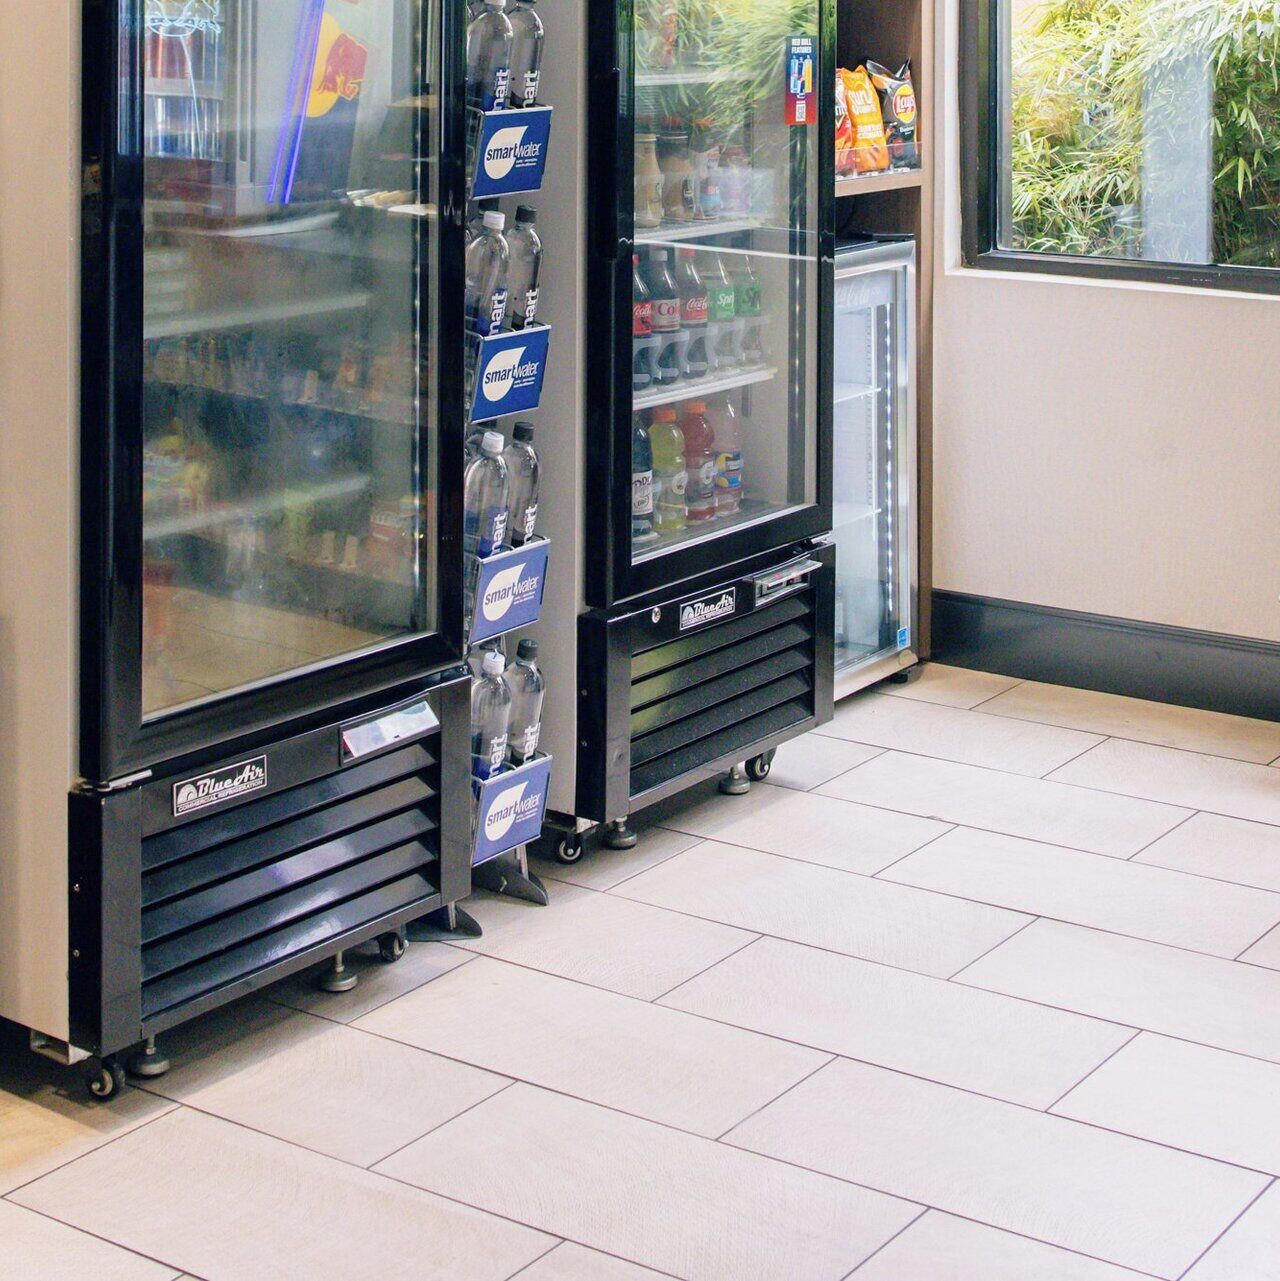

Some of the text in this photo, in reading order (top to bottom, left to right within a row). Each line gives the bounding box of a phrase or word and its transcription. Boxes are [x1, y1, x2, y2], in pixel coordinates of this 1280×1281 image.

[486, 142, 542, 162] smartwater
[485, 361, 540, 385] smartwater
[485, 575, 540, 606] smartwater
[196, 764, 265, 797] Blue Air
[486, 792, 542, 827] smartwater
